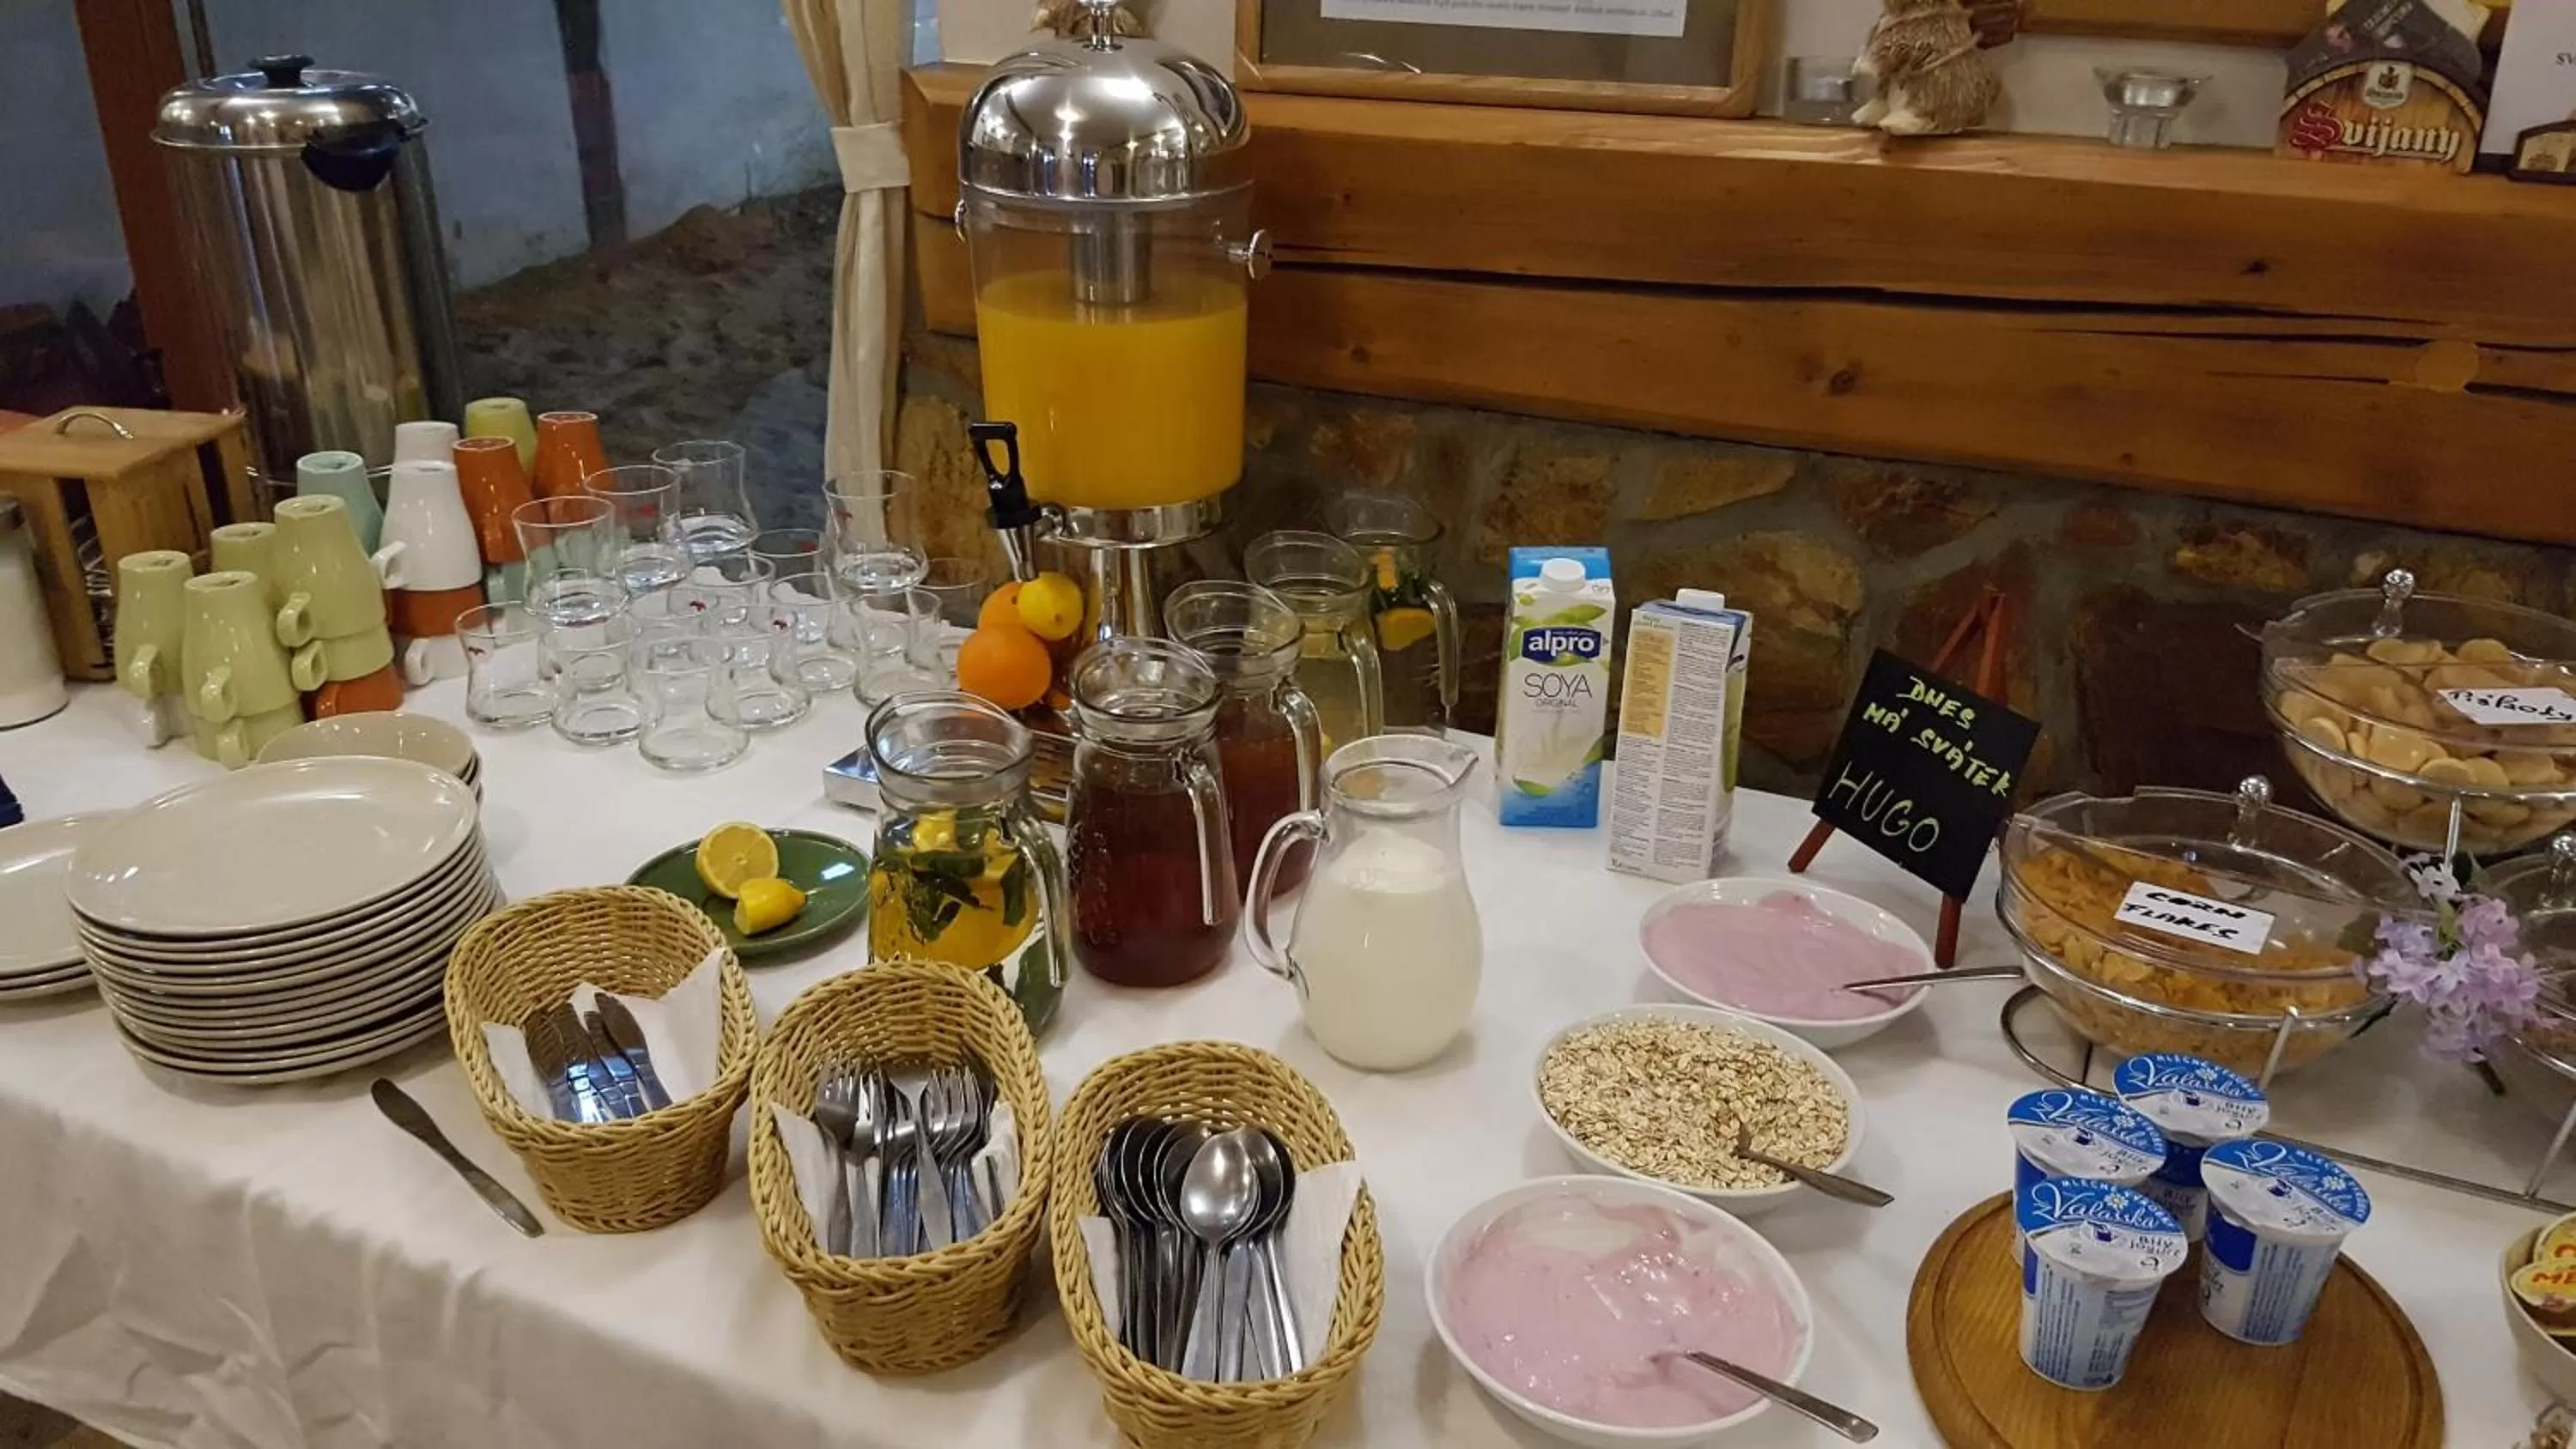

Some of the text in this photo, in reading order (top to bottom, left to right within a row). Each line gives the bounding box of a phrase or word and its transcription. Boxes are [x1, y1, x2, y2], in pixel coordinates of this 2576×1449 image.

[1528, 629, 1595, 657] alpro
[1522, 672, 1593, 698] SOYA
[1895, 676, 1976, 730] DNES
[1827, 760, 1941, 852] HUGO
[2123, 902, 2239, 940] FLAKES
